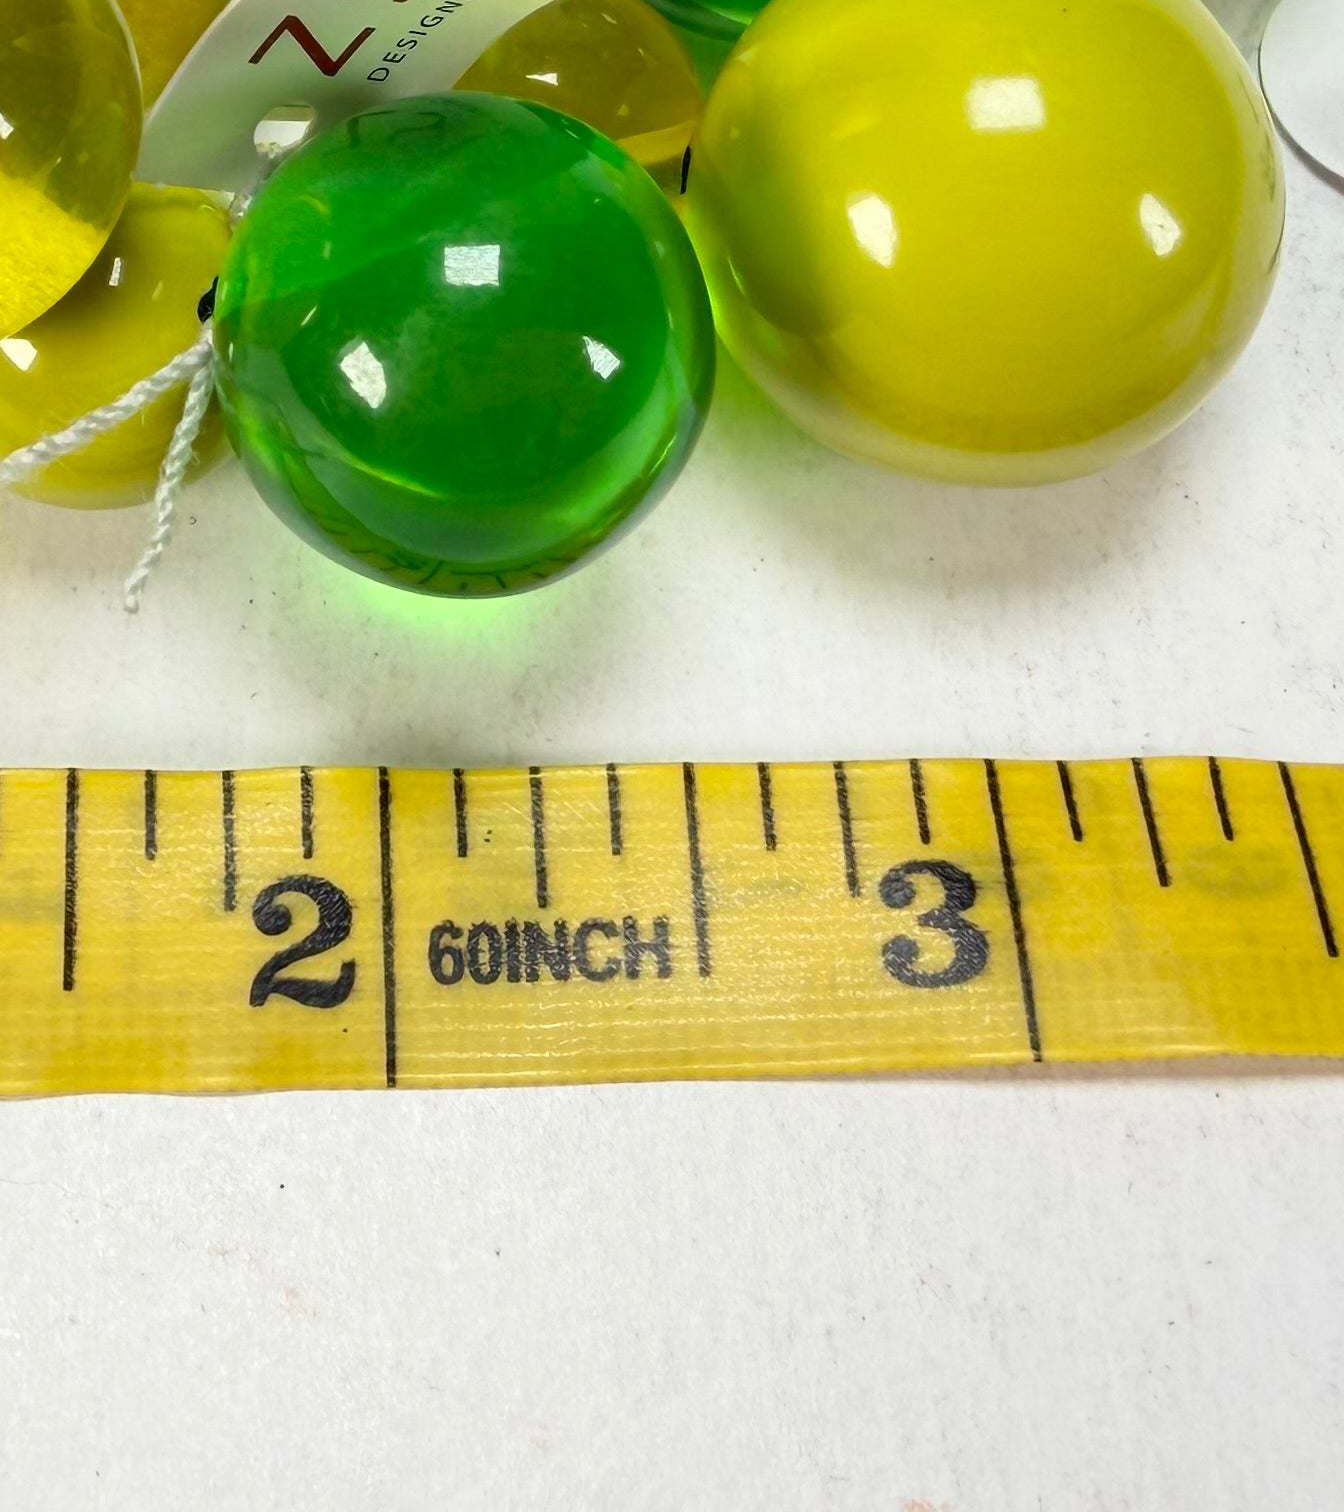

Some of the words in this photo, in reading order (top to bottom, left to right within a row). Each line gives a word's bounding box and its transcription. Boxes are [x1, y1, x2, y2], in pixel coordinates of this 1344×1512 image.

[250, 874, 356, 1009] 2
[428, 915, 672, 986] 60INCH
[879, 860, 991, 988] 3
